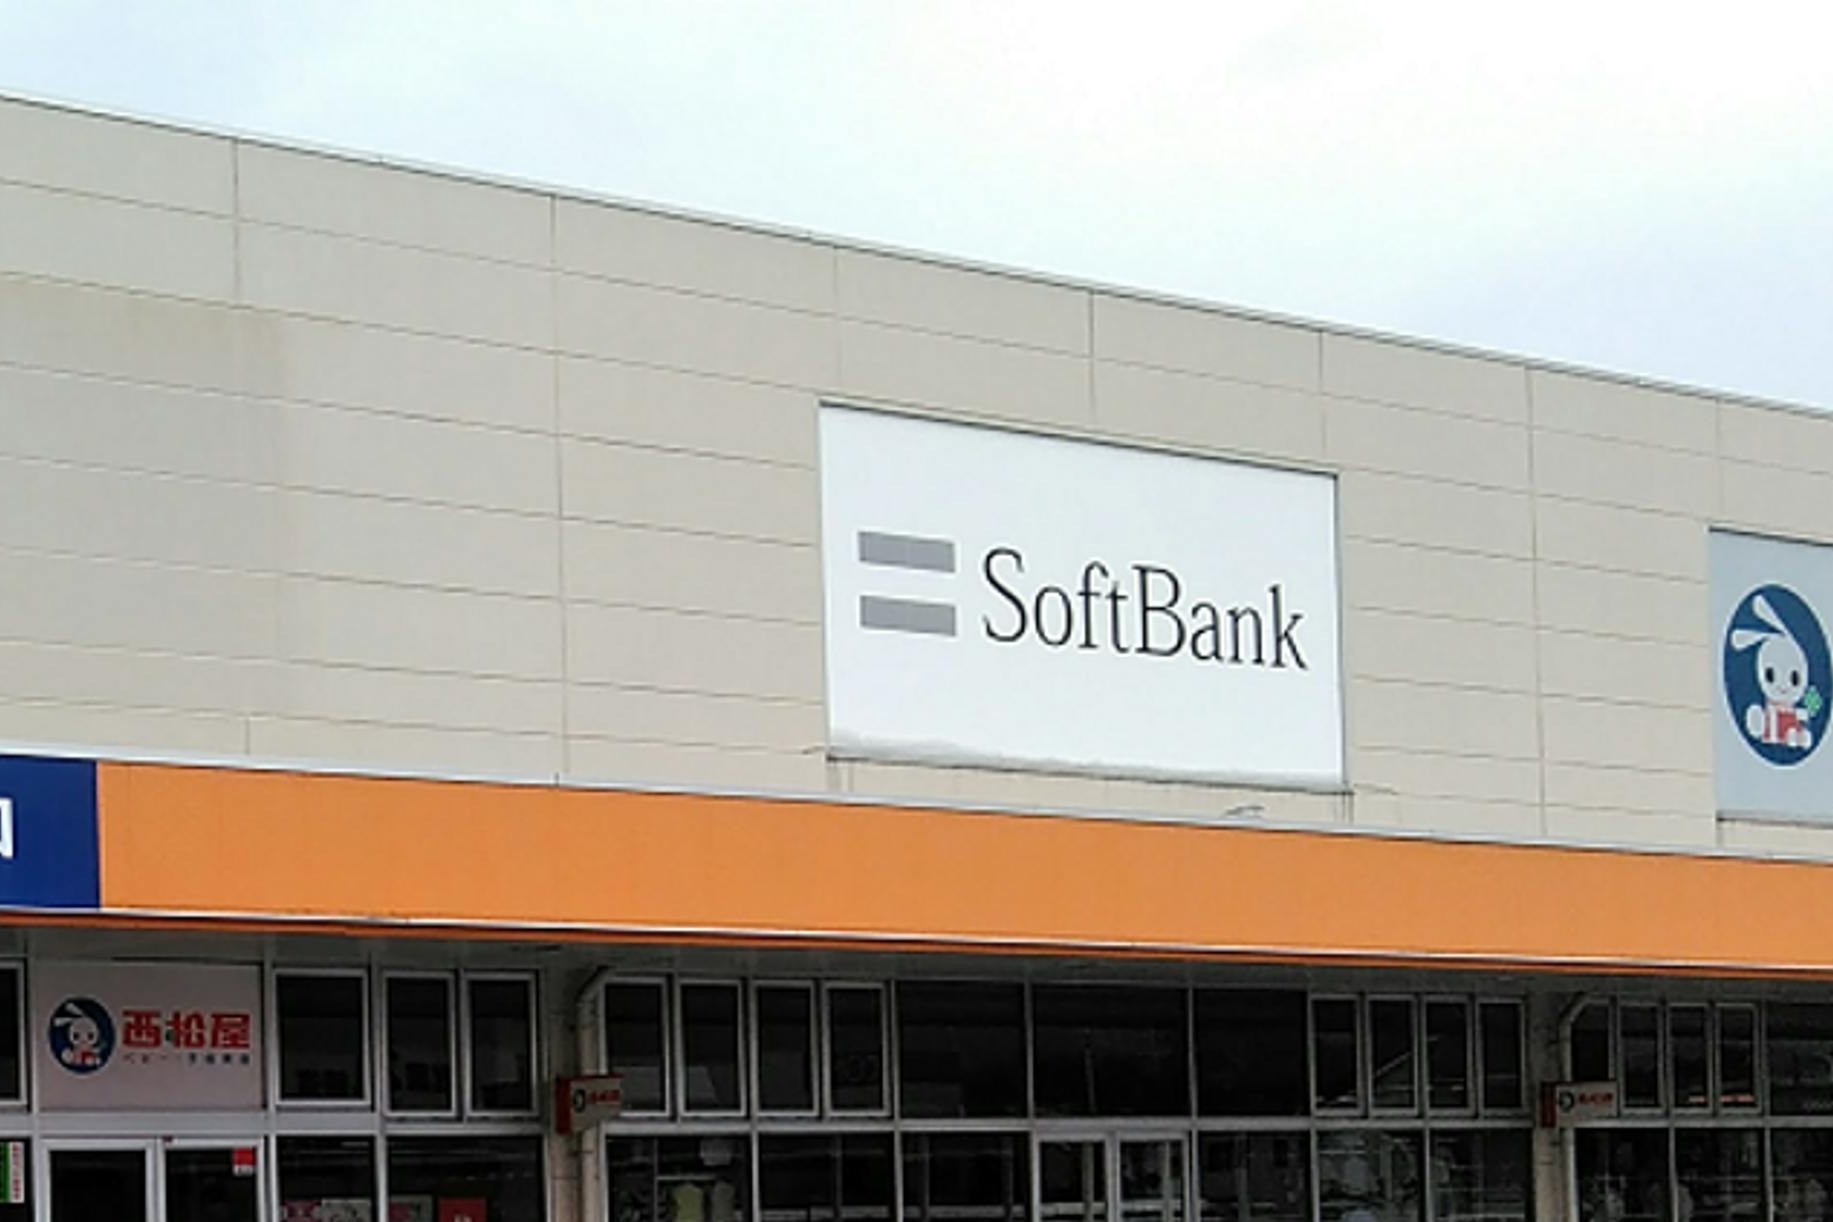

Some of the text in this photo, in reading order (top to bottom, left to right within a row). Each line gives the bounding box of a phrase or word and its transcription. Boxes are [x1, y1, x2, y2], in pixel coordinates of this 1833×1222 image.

[982, 546, 1308, 671] SoftBank
[122, 1010, 250, 1048] 西松屋
